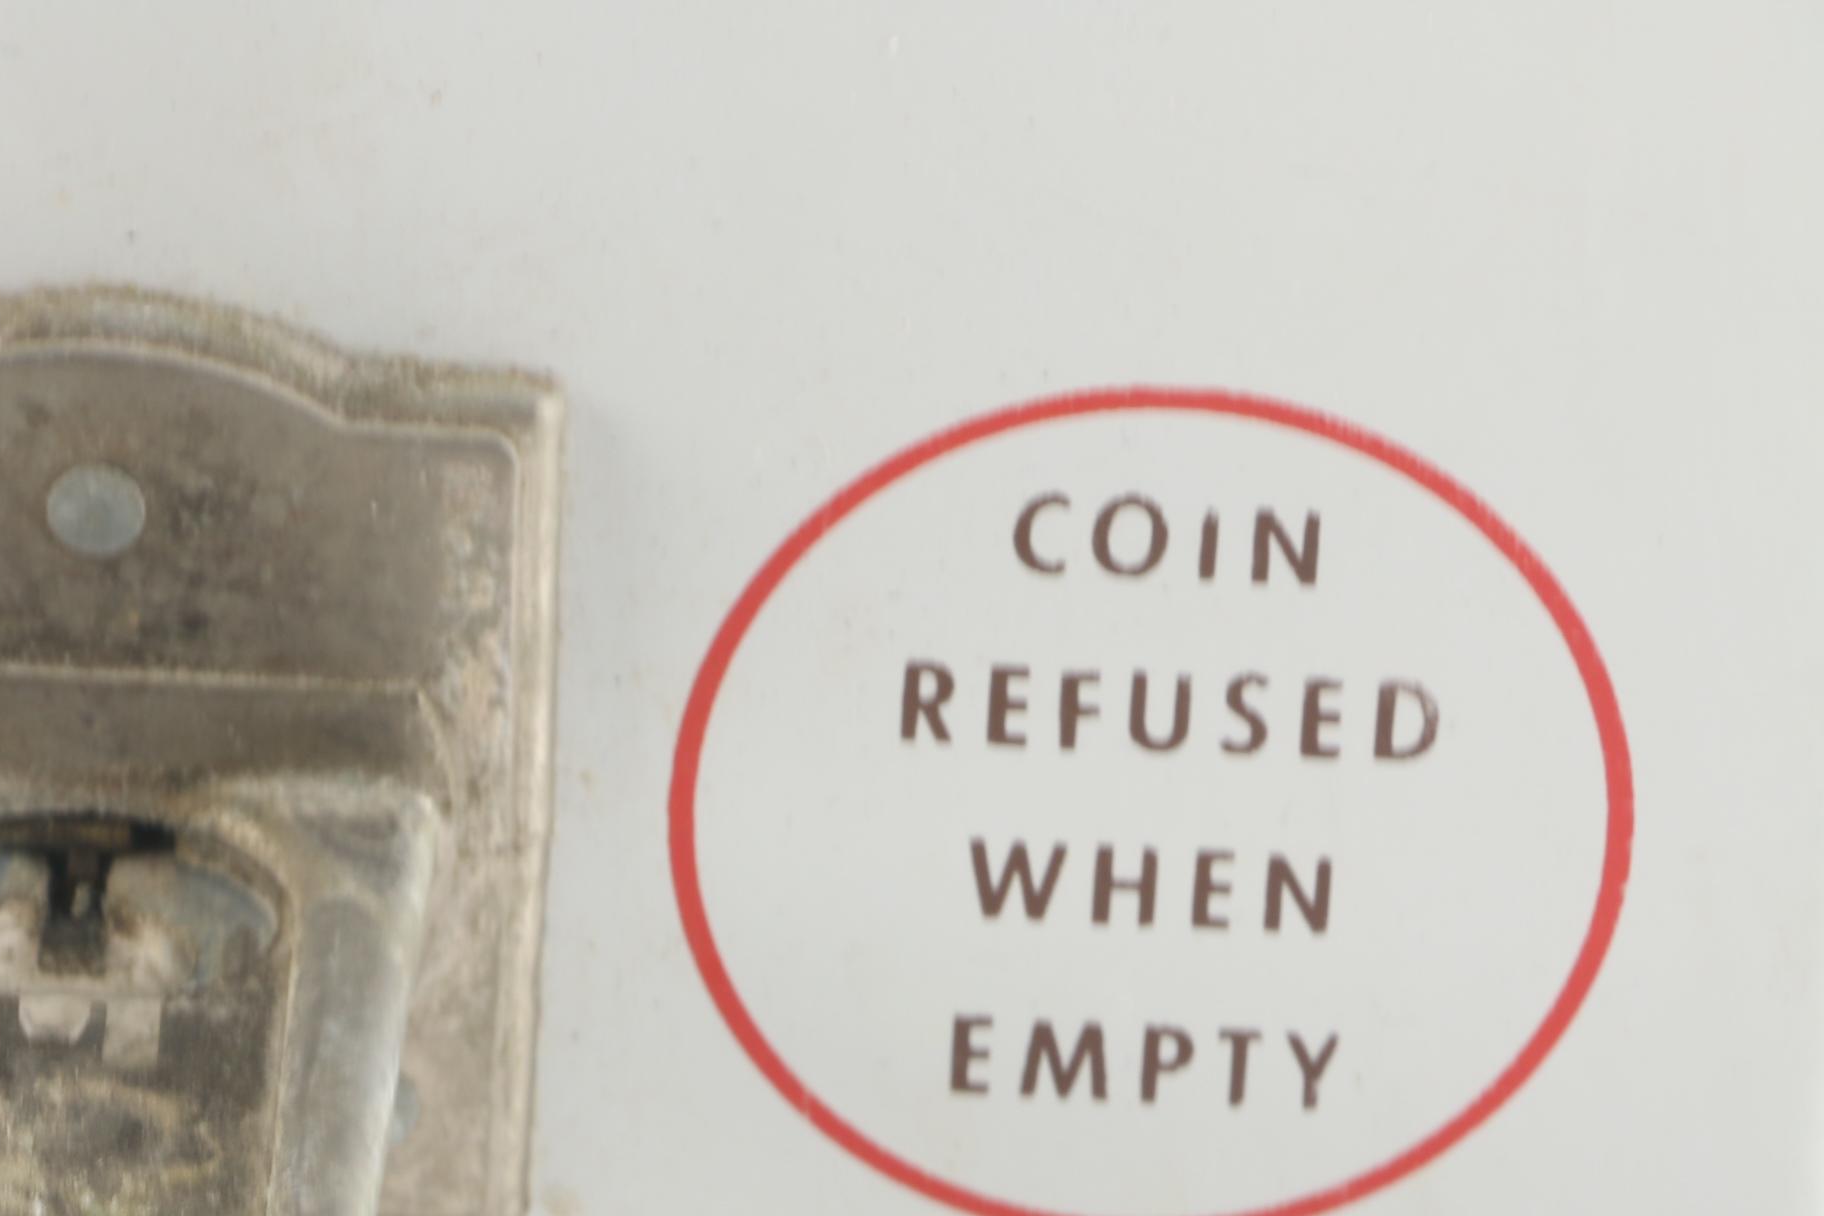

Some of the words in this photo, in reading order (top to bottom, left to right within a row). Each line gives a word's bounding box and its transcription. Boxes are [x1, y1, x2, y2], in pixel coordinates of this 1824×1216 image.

[1012, 492, 1322, 587] COIN
[899, 660, 1440, 762] REFUSED
[969, 837, 1333, 935] WHEN
[948, 1014, 1339, 1111] EMPTY
